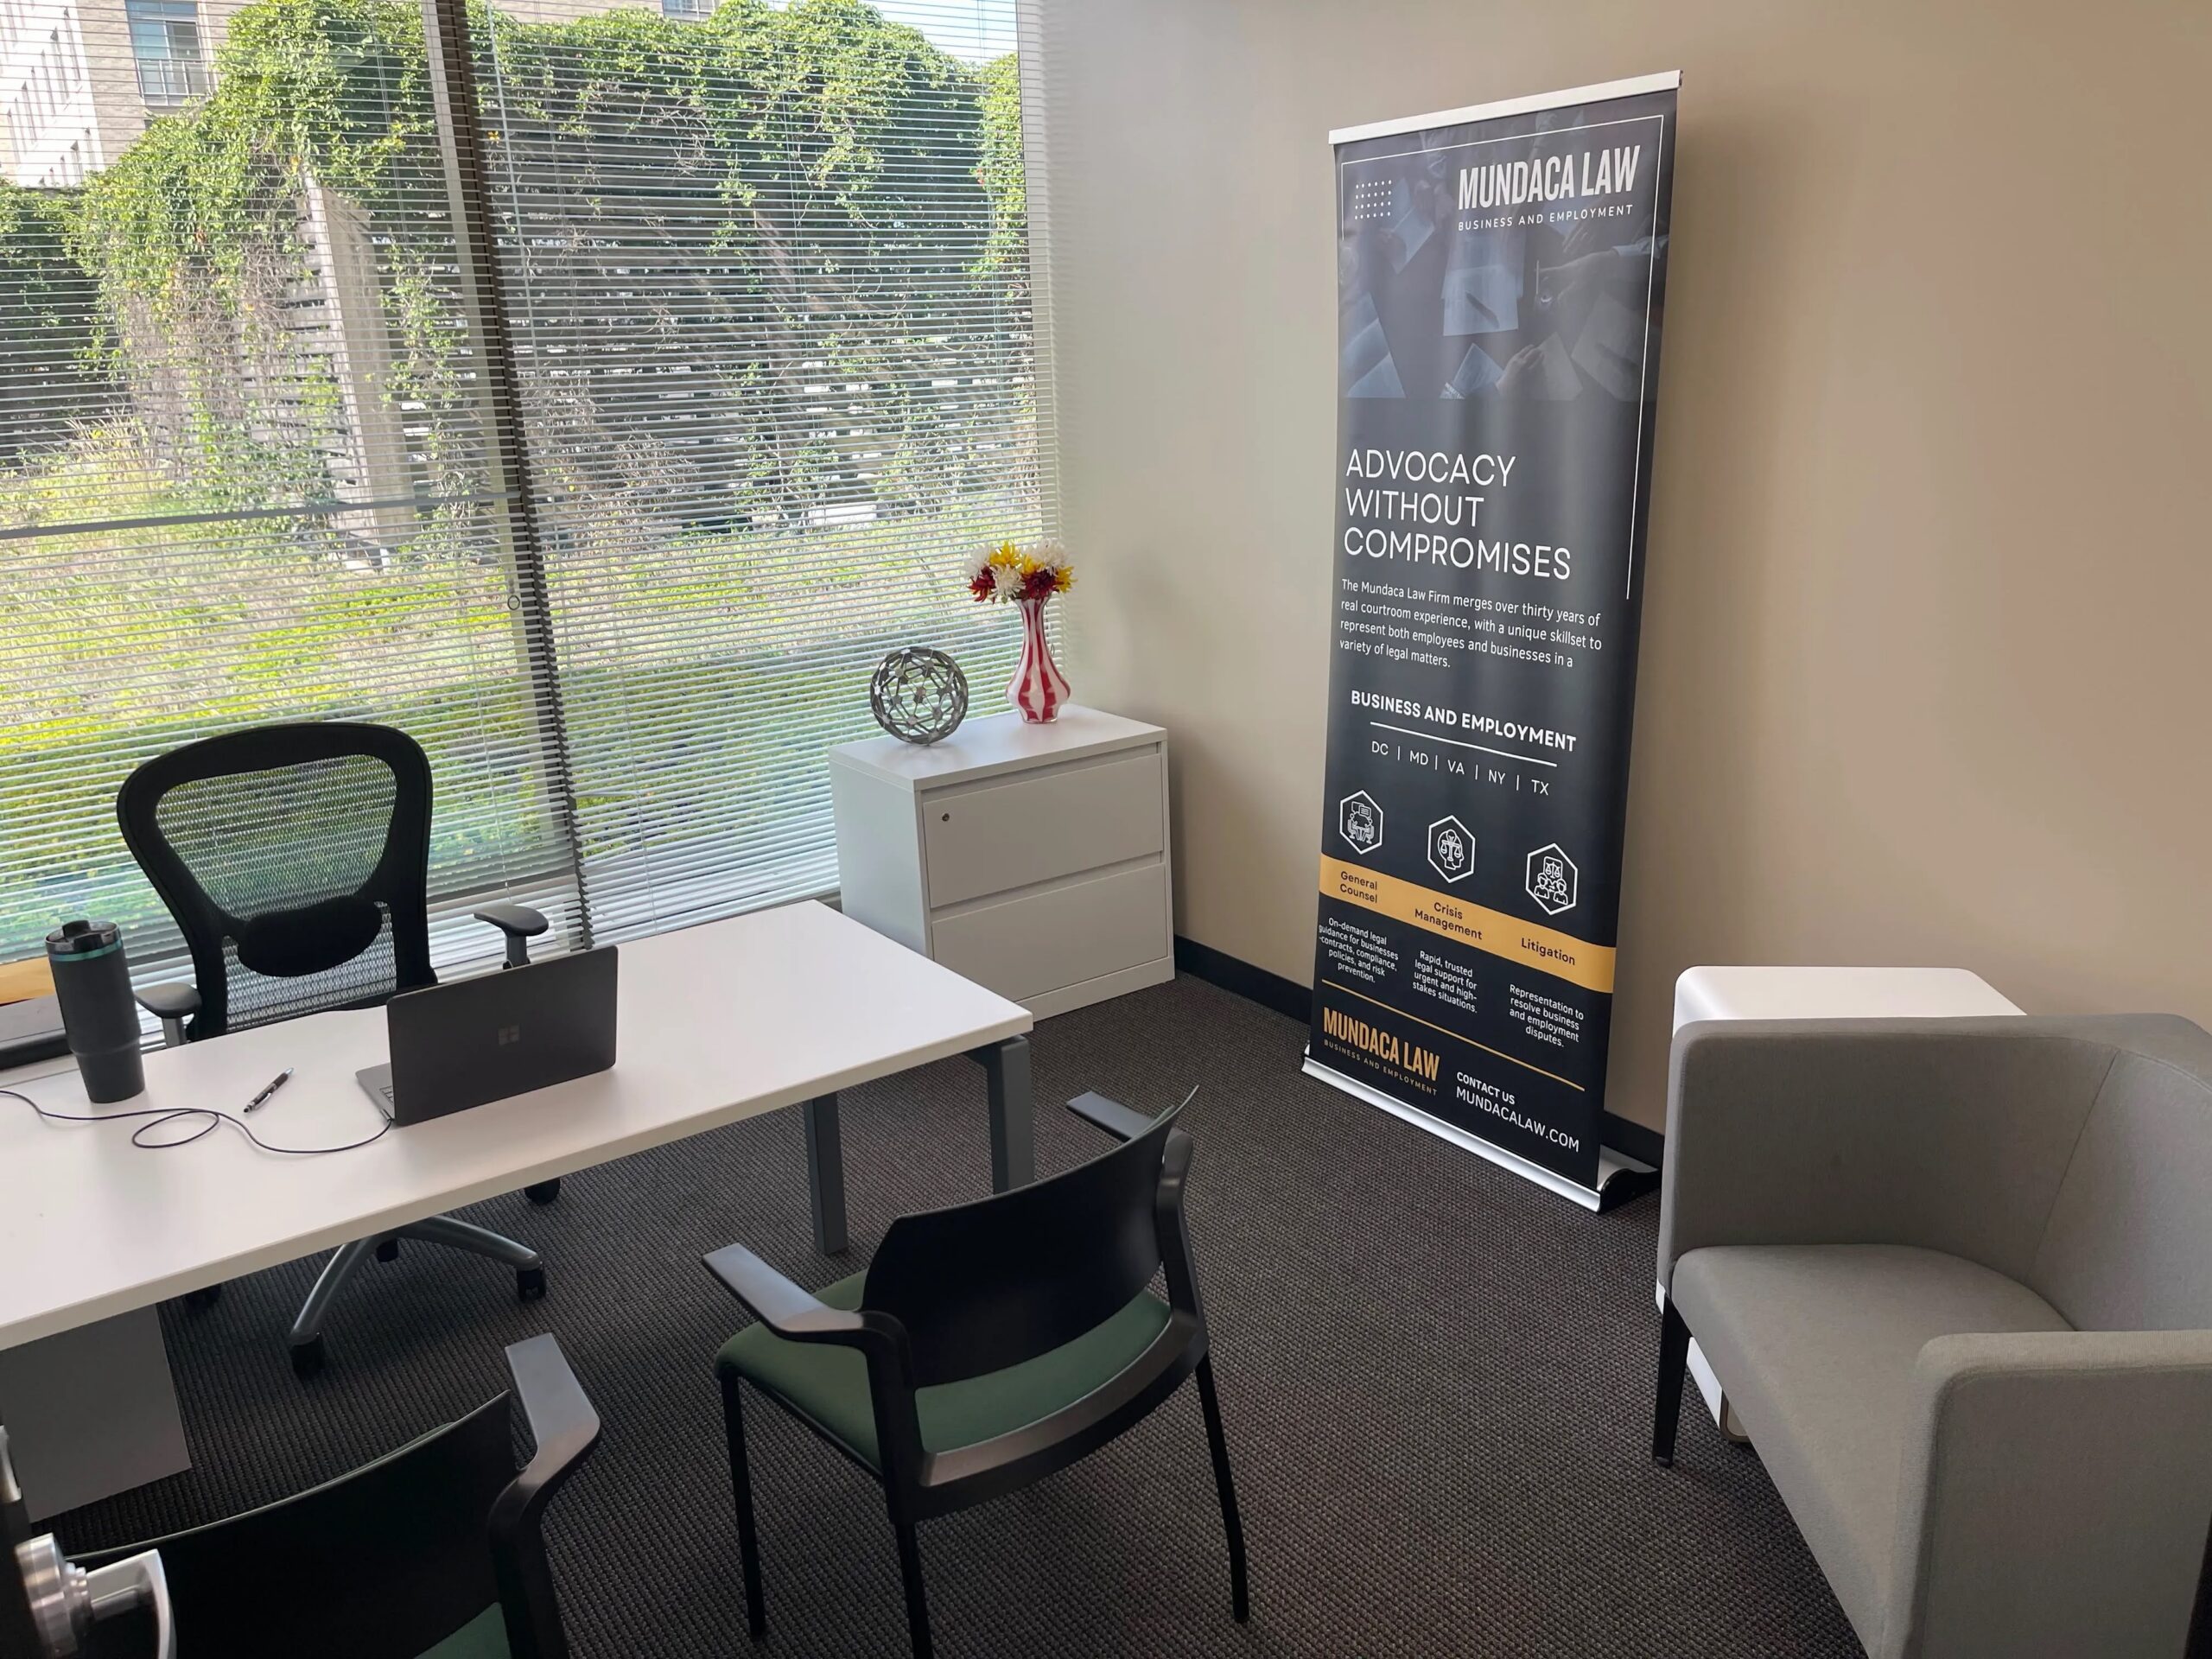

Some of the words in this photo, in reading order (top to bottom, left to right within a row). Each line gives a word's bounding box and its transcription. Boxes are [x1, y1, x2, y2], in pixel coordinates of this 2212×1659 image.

[1459, 153, 1574, 210] MUNDACA
[1581, 145, 1641, 197] LAW
[1458, 216, 1513, 231] BUSINESS
[1518, 213, 1544, 226] AND
[1549, 205, 1633, 222] EMPLOYMENT
[1345, 448, 1516, 486] ADVOCACY
[1344, 487, 1484, 527] WITHOUT
[1344, 527, 1571, 580] COMPROMISES
[1342, 579, 1358, 591] The
[1361, 581, 1404, 597] Mundaca
[1407, 588, 1426, 601] Law
[1428, 590, 1450, 604] Firm
[1453, 595, 1492, 611] merges
[1495, 601, 1519, 613] over
[1522, 602, 1554, 621] thirty
[1556, 609, 1585, 624] years
[1588, 613, 1601, 626] of
[1341, 600, 1357, 611] real
[1361, 603, 1411, 619] courtroom
[1414, 611, 1471, 630] experience,
[1474, 619, 1495, 632] with
[1498, 624, 1504, 633] a
[1508, 625, 1547, 641] unique
[1550, 629, 1586, 648] skillset
[1590, 637, 1602, 650] to
[1339, 639, 1371, 655] variety
[1374, 643, 1384, 655] of
[1386, 645, 1408, 660] legal
[1411, 652, 1451, 667] matters.
[1340, 620, 1386, 636] represent
[1389, 625, 1409, 639] both
[1412, 632, 1465, 649] employees
[1468, 640, 1488, 652] and
[1491, 641, 1551, 664] businesses
[1554, 652, 1564, 666] in
[1567, 658, 1573, 668] a
[1351, 690, 1421, 718] BUSINESS
[1424, 705, 1457, 726] AND
[1461, 712, 1577, 752] EMPLOYMENT
[1371, 741, 1389, 755] DC
[1409, 750, 1428, 766] MD
[1447, 760, 1465, 775] VA
[1488, 769, 1505, 785] NY
[1531, 779, 1549, 796] TX
[1339, 883, 1377, 904] Counsel
[1340, 870, 1377, 891] General
[1414, 908, 1483, 940] Management
[1433, 901, 1463, 920] Crisis
[1328, 918, 1369, 938] On-demand
[1370, 931, 1387, 945] legal
[1350, 934, 1359, 944] for
[1360, 938, 1399, 961] businesses
[1357, 960, 1370, 970] and
[1372, 965, 1385, 976] risk
[1420, 950, 1443, 968] Rapid,
[1445, 960, 1472, 977] trusted
[1521, 938, 1576, 966] Litigation
[1338, 963, 1376, 983] prevention.
[1414, 959, 1433, 973] legal
[1434, 968, 1464, 986] support
[1465, 978, 1478, 990] for
[1414, 971, 1439, 987] urgent
[1440, 982, 1454, 993] and
[1457, 986, 1477, 1001] high-
[1413, 982, 1436, 996] stakes
[1438, 991, 1478, 1014] situations.
[1510, 984, 1573, 1015] Representation
[1575, 1009, 1584, 1020] to
[1510, 997, 1541, 1014] resolve
[1542, 1007, 1580, 1030] business
[1510, 1008, 1525, 1020] and
[1527, 1015, 1579, 1043] employment
[1525, 1025, 1564, 1047] disputes.
[1324, 1007, 1400, 1065] MUNDACA
[1403, 1041, 1440, 1082] LAW
[1324, 1039, 1360, 1061] BUSINESS
[1363, 1058, 1380, 1070] AND
[1383, 1066, 1437, 1096] EMPLOYMENT
[1457, 1071, 1500, 1098] CONTACT
[1502, 1091, 1516, 1105] US
[1456, 1085, 1580, 1153] MUNDACALAW.COM
